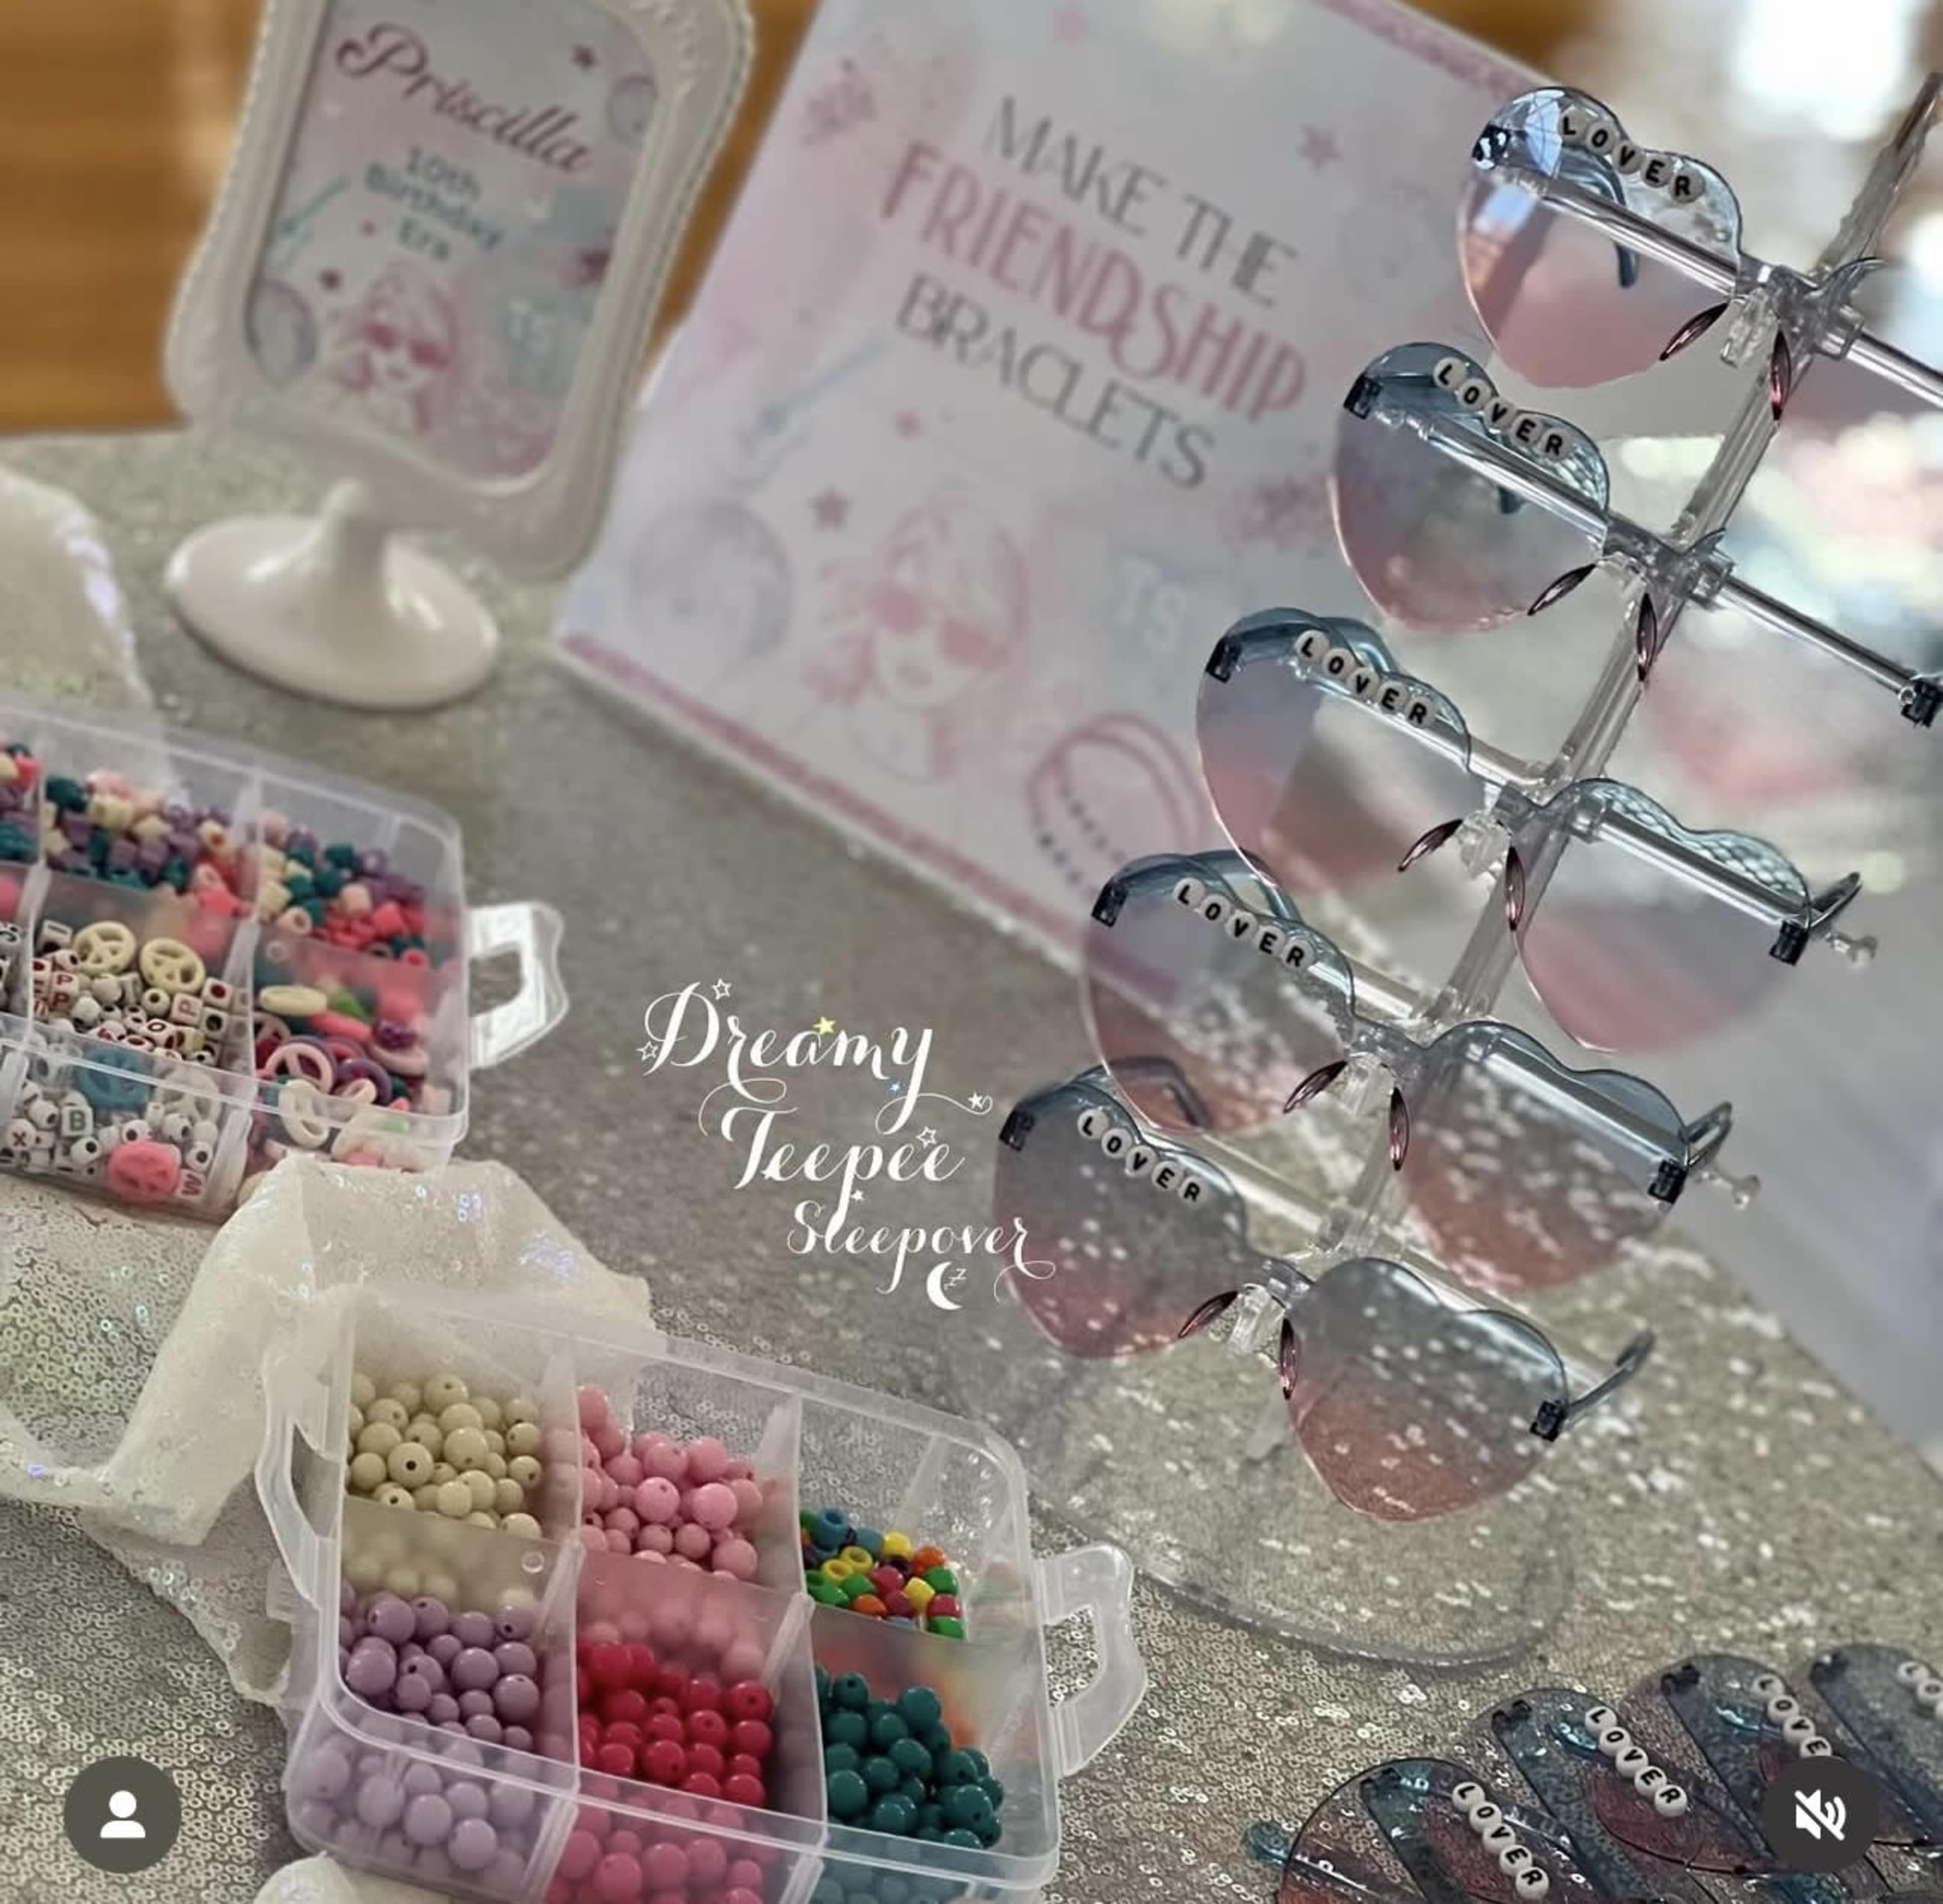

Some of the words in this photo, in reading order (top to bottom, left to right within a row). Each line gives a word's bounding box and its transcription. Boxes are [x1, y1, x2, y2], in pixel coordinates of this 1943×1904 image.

[334, 22, 589, 173] Priscilla
[981, 96, 1169, 238] MAKE
[1177, 192, 1298, 308] THE
[1562, 115, 1691, 197] LOVER
[880, 138, 1308, 424] FRIENDSHIP
[895, 272, 1216, 489] BRACLETS
[1438, 363, 1563, 456] LOVER
[1300, 637, 1427, 724] LOVER
[1177, 885, 1305, 967] LOVER
[1082, 1115, 1201, 1203] LOVER
[1590, 1709, 1682, 1804] LOVER
[1758, 1678, 1829, 1755] LOVE
[1457, 1785, 1543, 1886] LOVER
